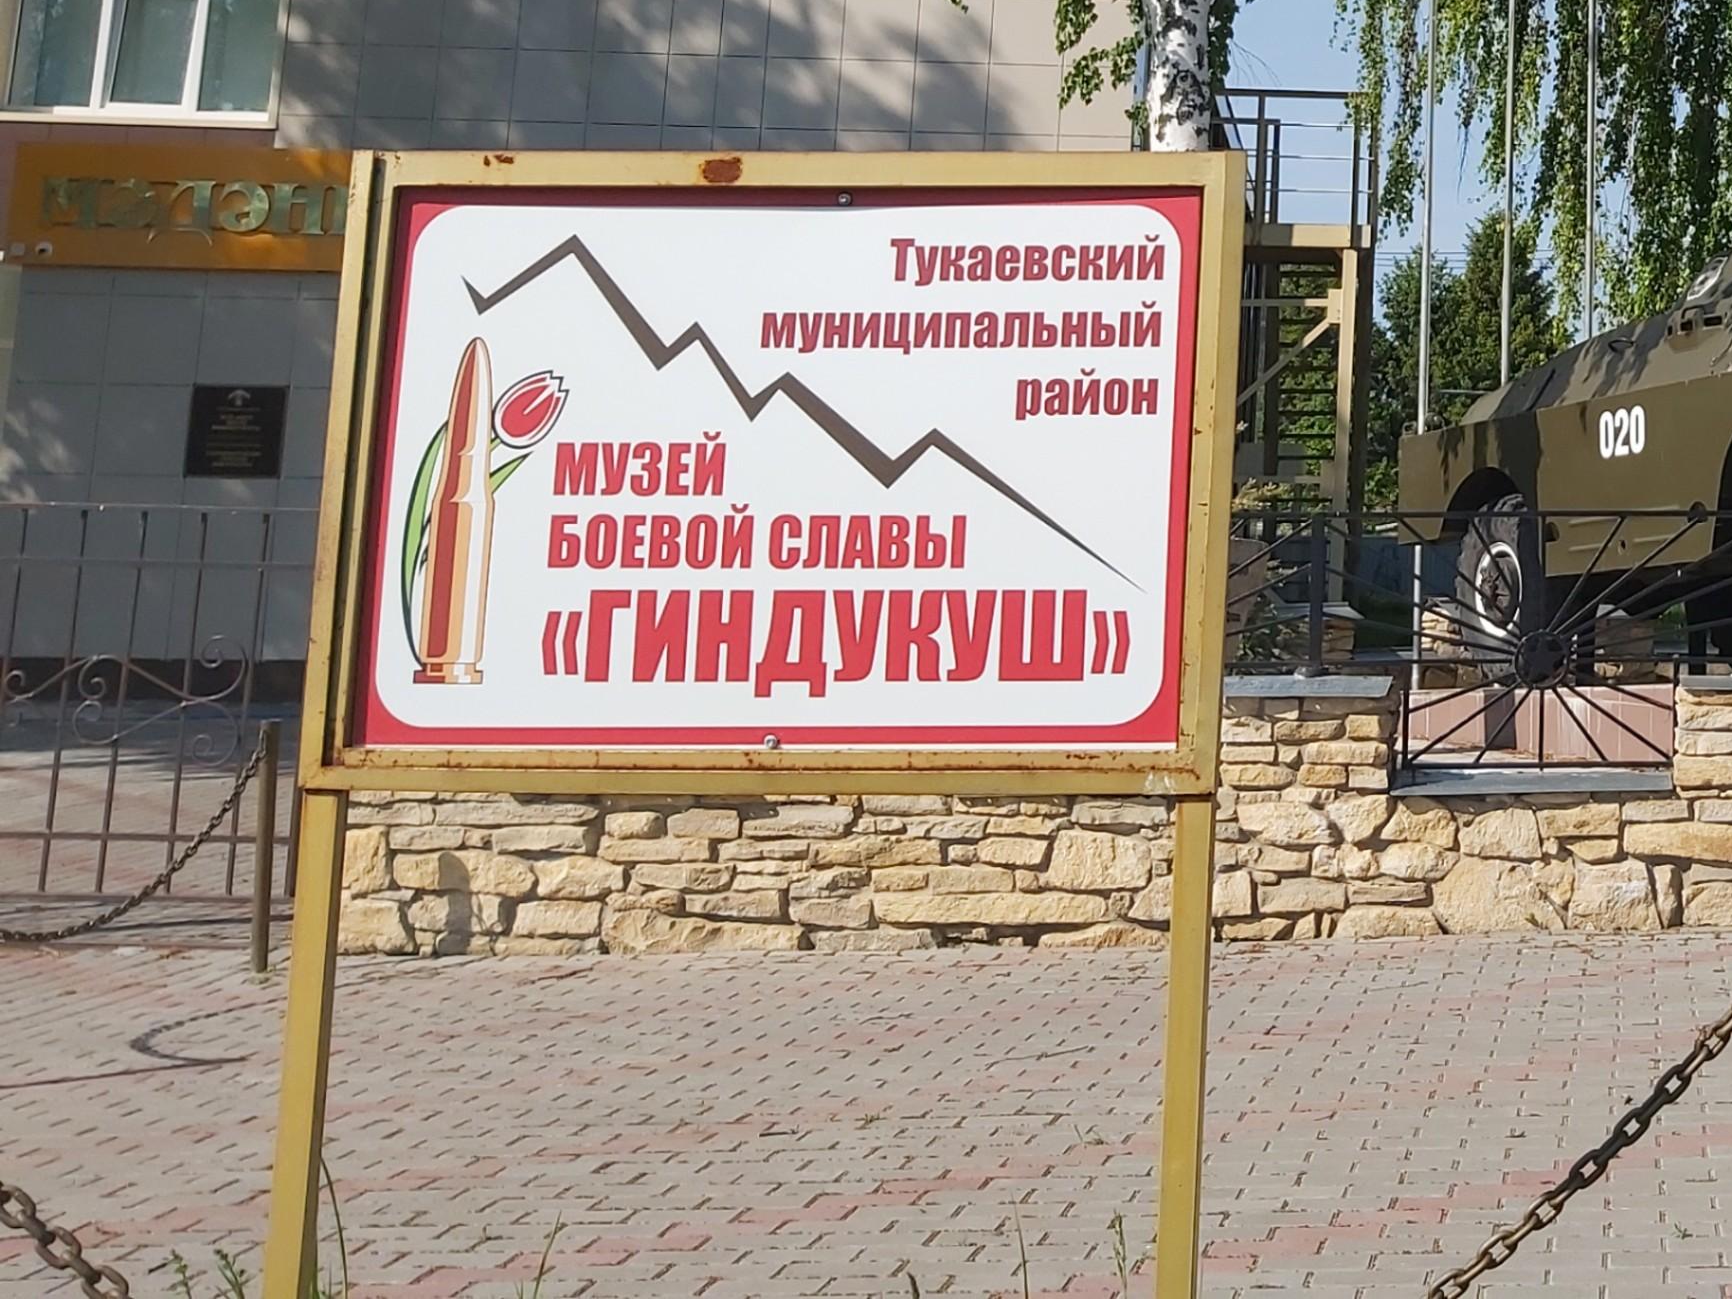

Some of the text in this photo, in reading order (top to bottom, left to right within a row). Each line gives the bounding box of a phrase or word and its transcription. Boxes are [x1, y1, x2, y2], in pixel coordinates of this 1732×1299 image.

[891, 233, 1165, 286] Тукаевский
[761, 300, 1163, 354] муниципальный
[1015, 367, 1160, 421] район
[1599, 405, 1646, 459] 020
[552, 430, 726, 497] МУЗЕЙ
[546, 502, 967, 570] БОЕВОЙ СЛАВЫ
[542, 589, 1130, 698] «ГИНДУКУШ»
